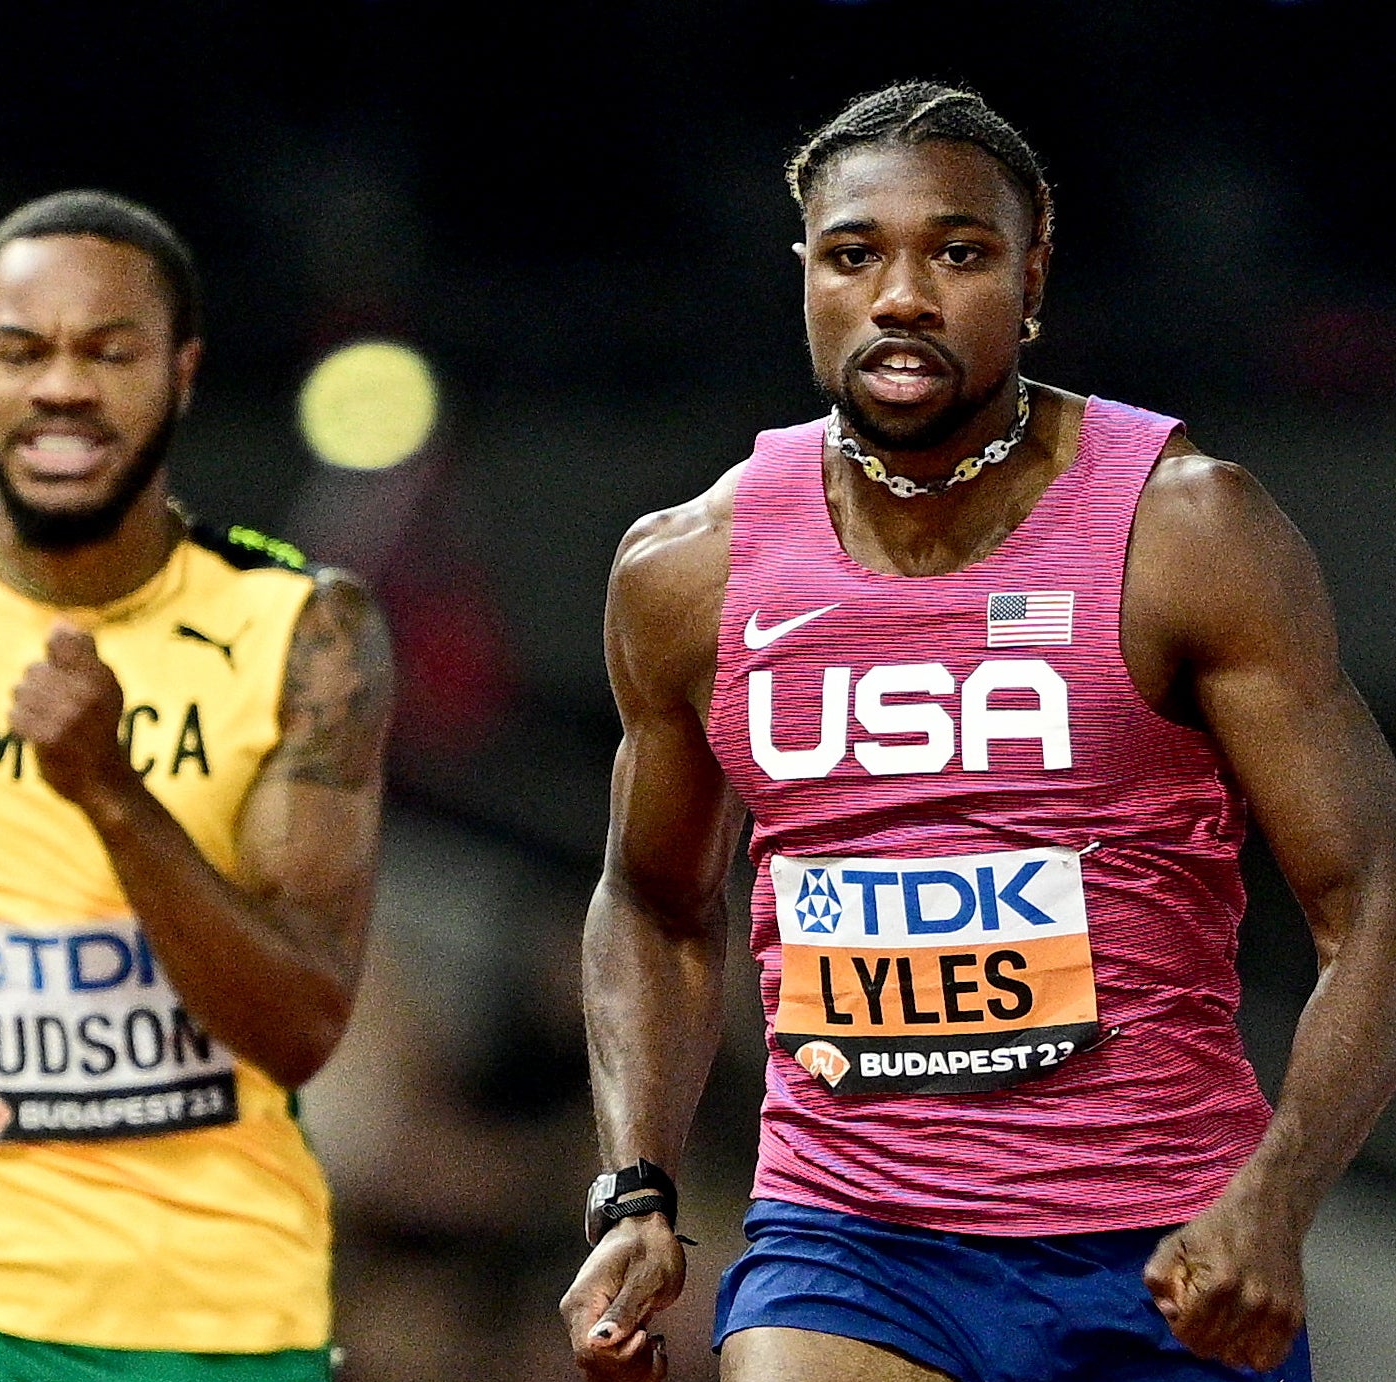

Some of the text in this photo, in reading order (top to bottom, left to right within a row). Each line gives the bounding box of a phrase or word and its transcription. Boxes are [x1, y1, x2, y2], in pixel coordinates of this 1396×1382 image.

[748, 659, 1073, 780] USA
[841, 860, 1057, 935] TDK
[819, 950, 1034, 1026] LYLES
[859, 1046, 1033, 1078] BUDAPEST
[18, 1091, 183, 1129] BUDAPEST
